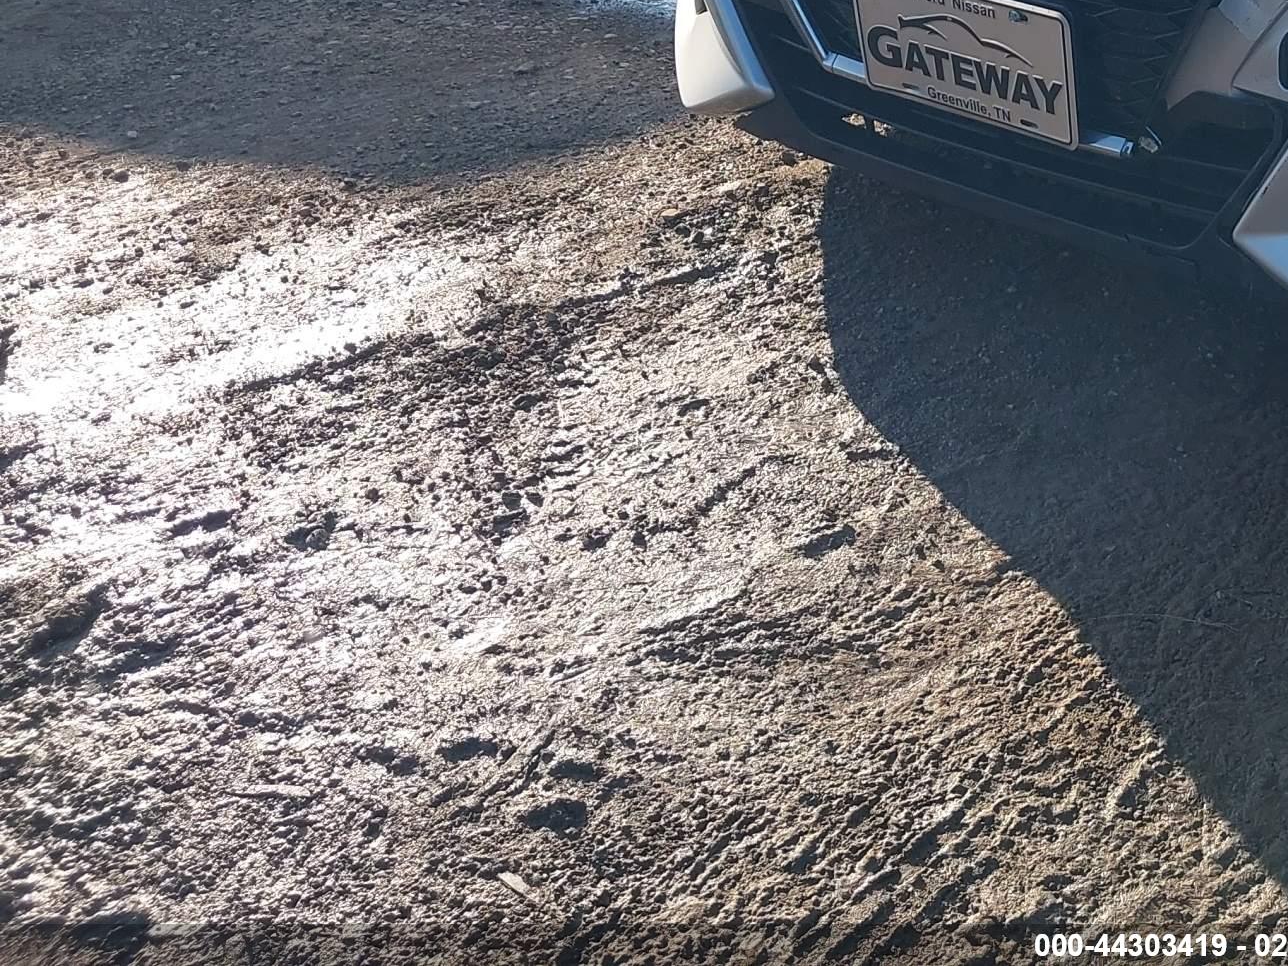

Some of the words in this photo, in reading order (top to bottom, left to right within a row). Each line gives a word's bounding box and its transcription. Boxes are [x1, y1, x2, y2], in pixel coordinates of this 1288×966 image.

[867, 25, 1064, 115] GATEWAY
[927, 86, 991, 118] Greenville,
[993, 105, 1012, 123] TN
